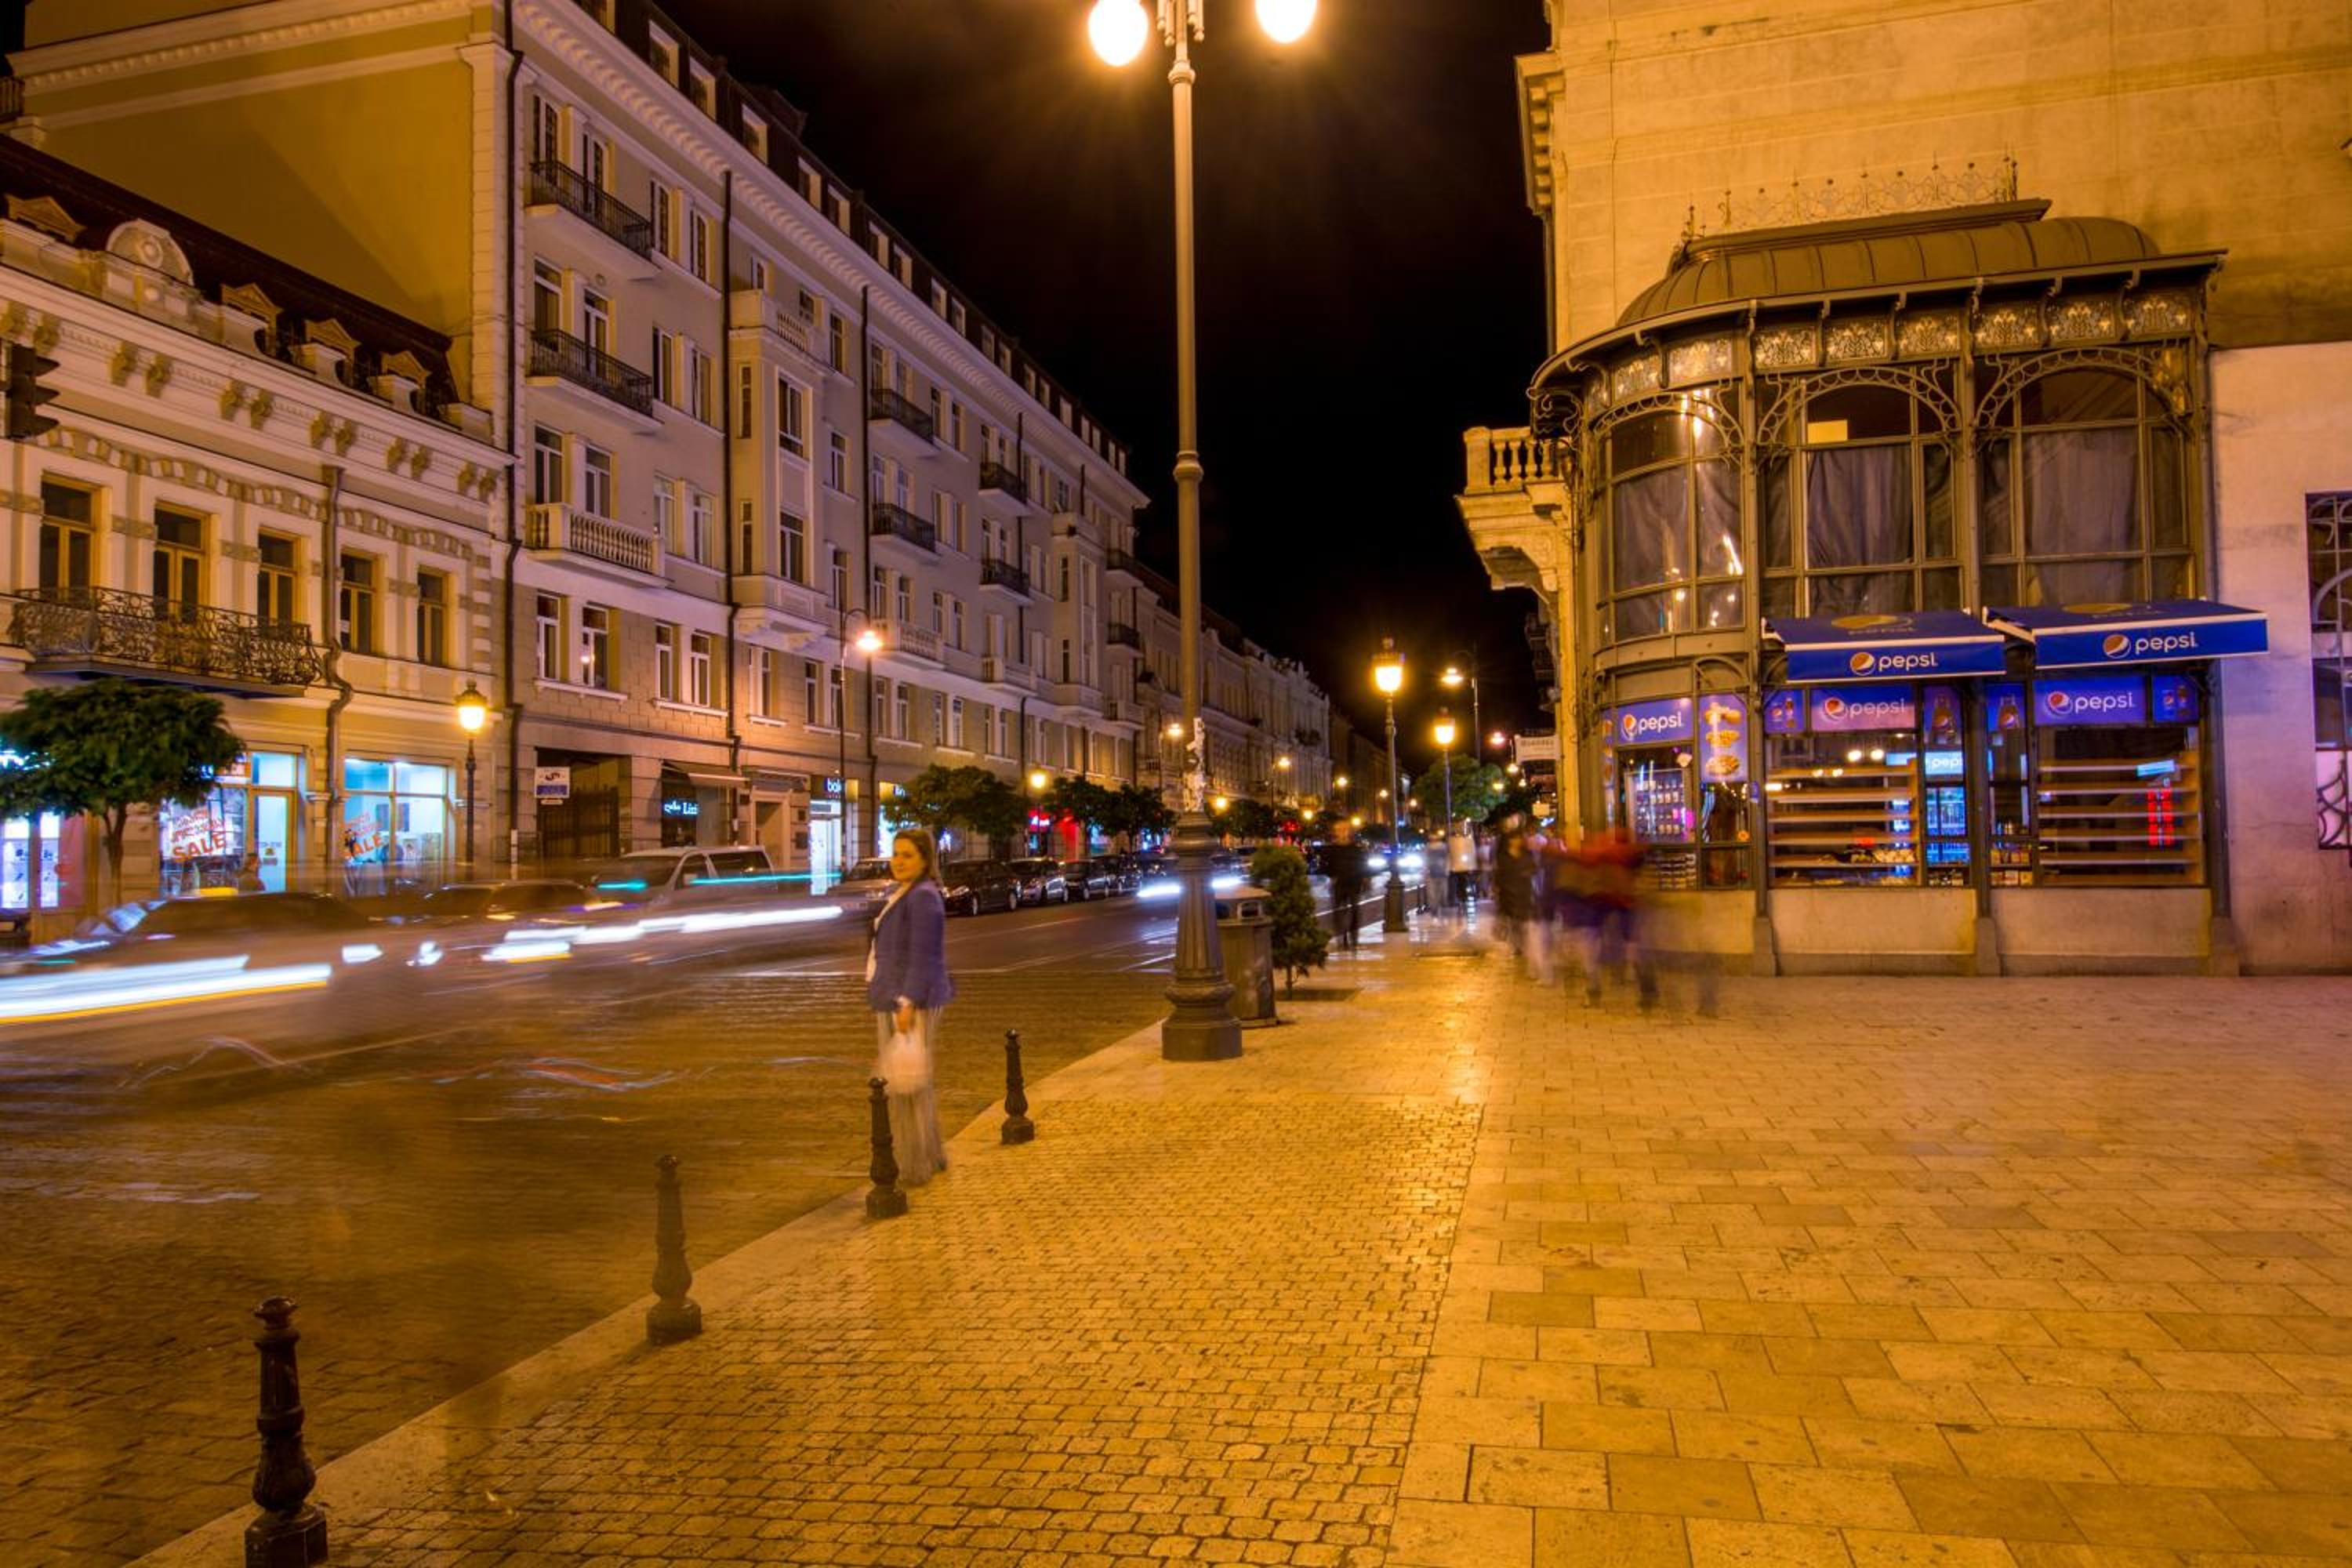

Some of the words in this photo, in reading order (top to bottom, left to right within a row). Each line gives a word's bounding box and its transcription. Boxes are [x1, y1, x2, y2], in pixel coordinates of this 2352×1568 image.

[2135, 631, 2197, 655] pepsi
[1878, 652, 1937, 672] pepsi
[1849, 697, 1906, 718] pepsi
[2074, 691, 2133, 713] pepsi
[1637, 711, 1682, 735] pepsi
[173, 832, 226, 863] SALE
